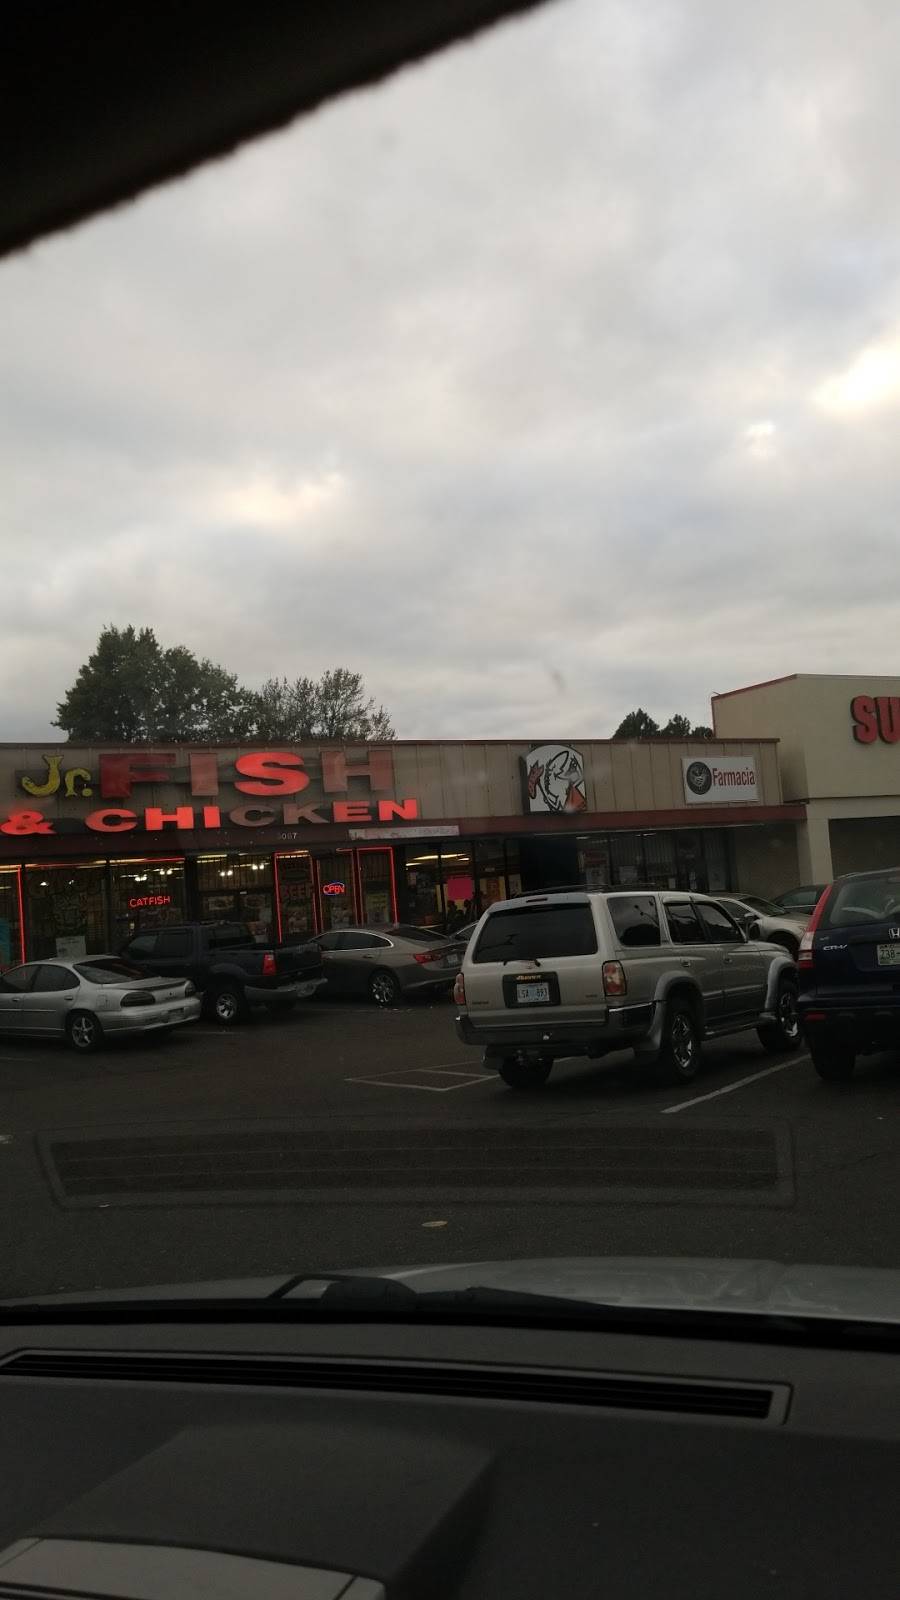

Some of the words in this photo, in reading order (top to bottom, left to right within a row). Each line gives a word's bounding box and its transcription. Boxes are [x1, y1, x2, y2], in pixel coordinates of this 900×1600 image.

[21, 754, 94, 798] Jr.
[98, 751, 394, 799] FISH
[712, 767, 756, 787] Farmacia
[0, 810, 56, 836] &
[85, 798, 419, 833] CHICKEN
[322, 883, 346, 895] OPEN
[128, 895, 172, 909] CATFISH
